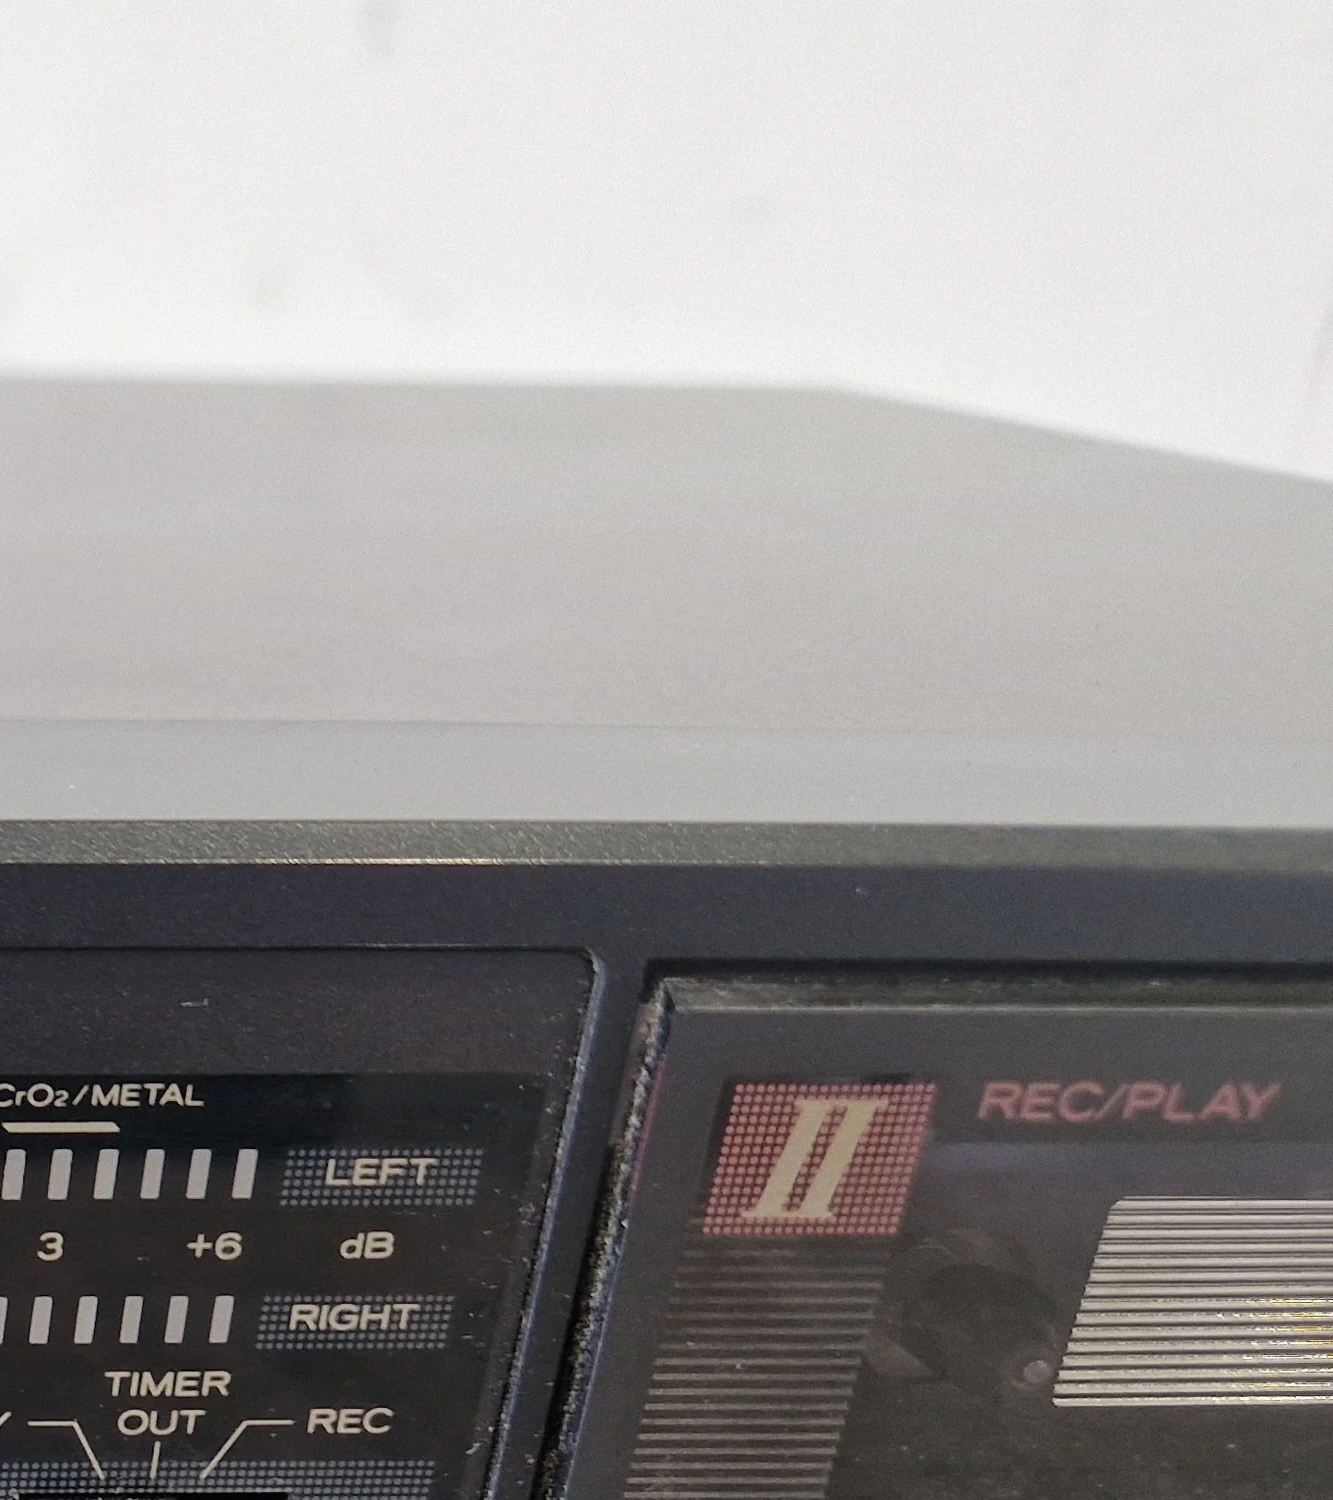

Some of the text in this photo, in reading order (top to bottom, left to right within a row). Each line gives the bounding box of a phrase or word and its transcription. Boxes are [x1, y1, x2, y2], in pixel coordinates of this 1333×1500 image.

[978, 1082, 1281, 1123] REC/PLAY
[324, 1157, 439, 1187] LEFT
[37, 1232, 64, 1262] 3
[187, 1232, 243, 1261] +6
[339, 1231, 396, 1261] dB
[288, 1303, 421, 1332] RIGHT
[104, 1370, 232, 1398] TIMER
[116, 1409, 206, 1436] OUT
[306, 1407, 395, 1434] REC
